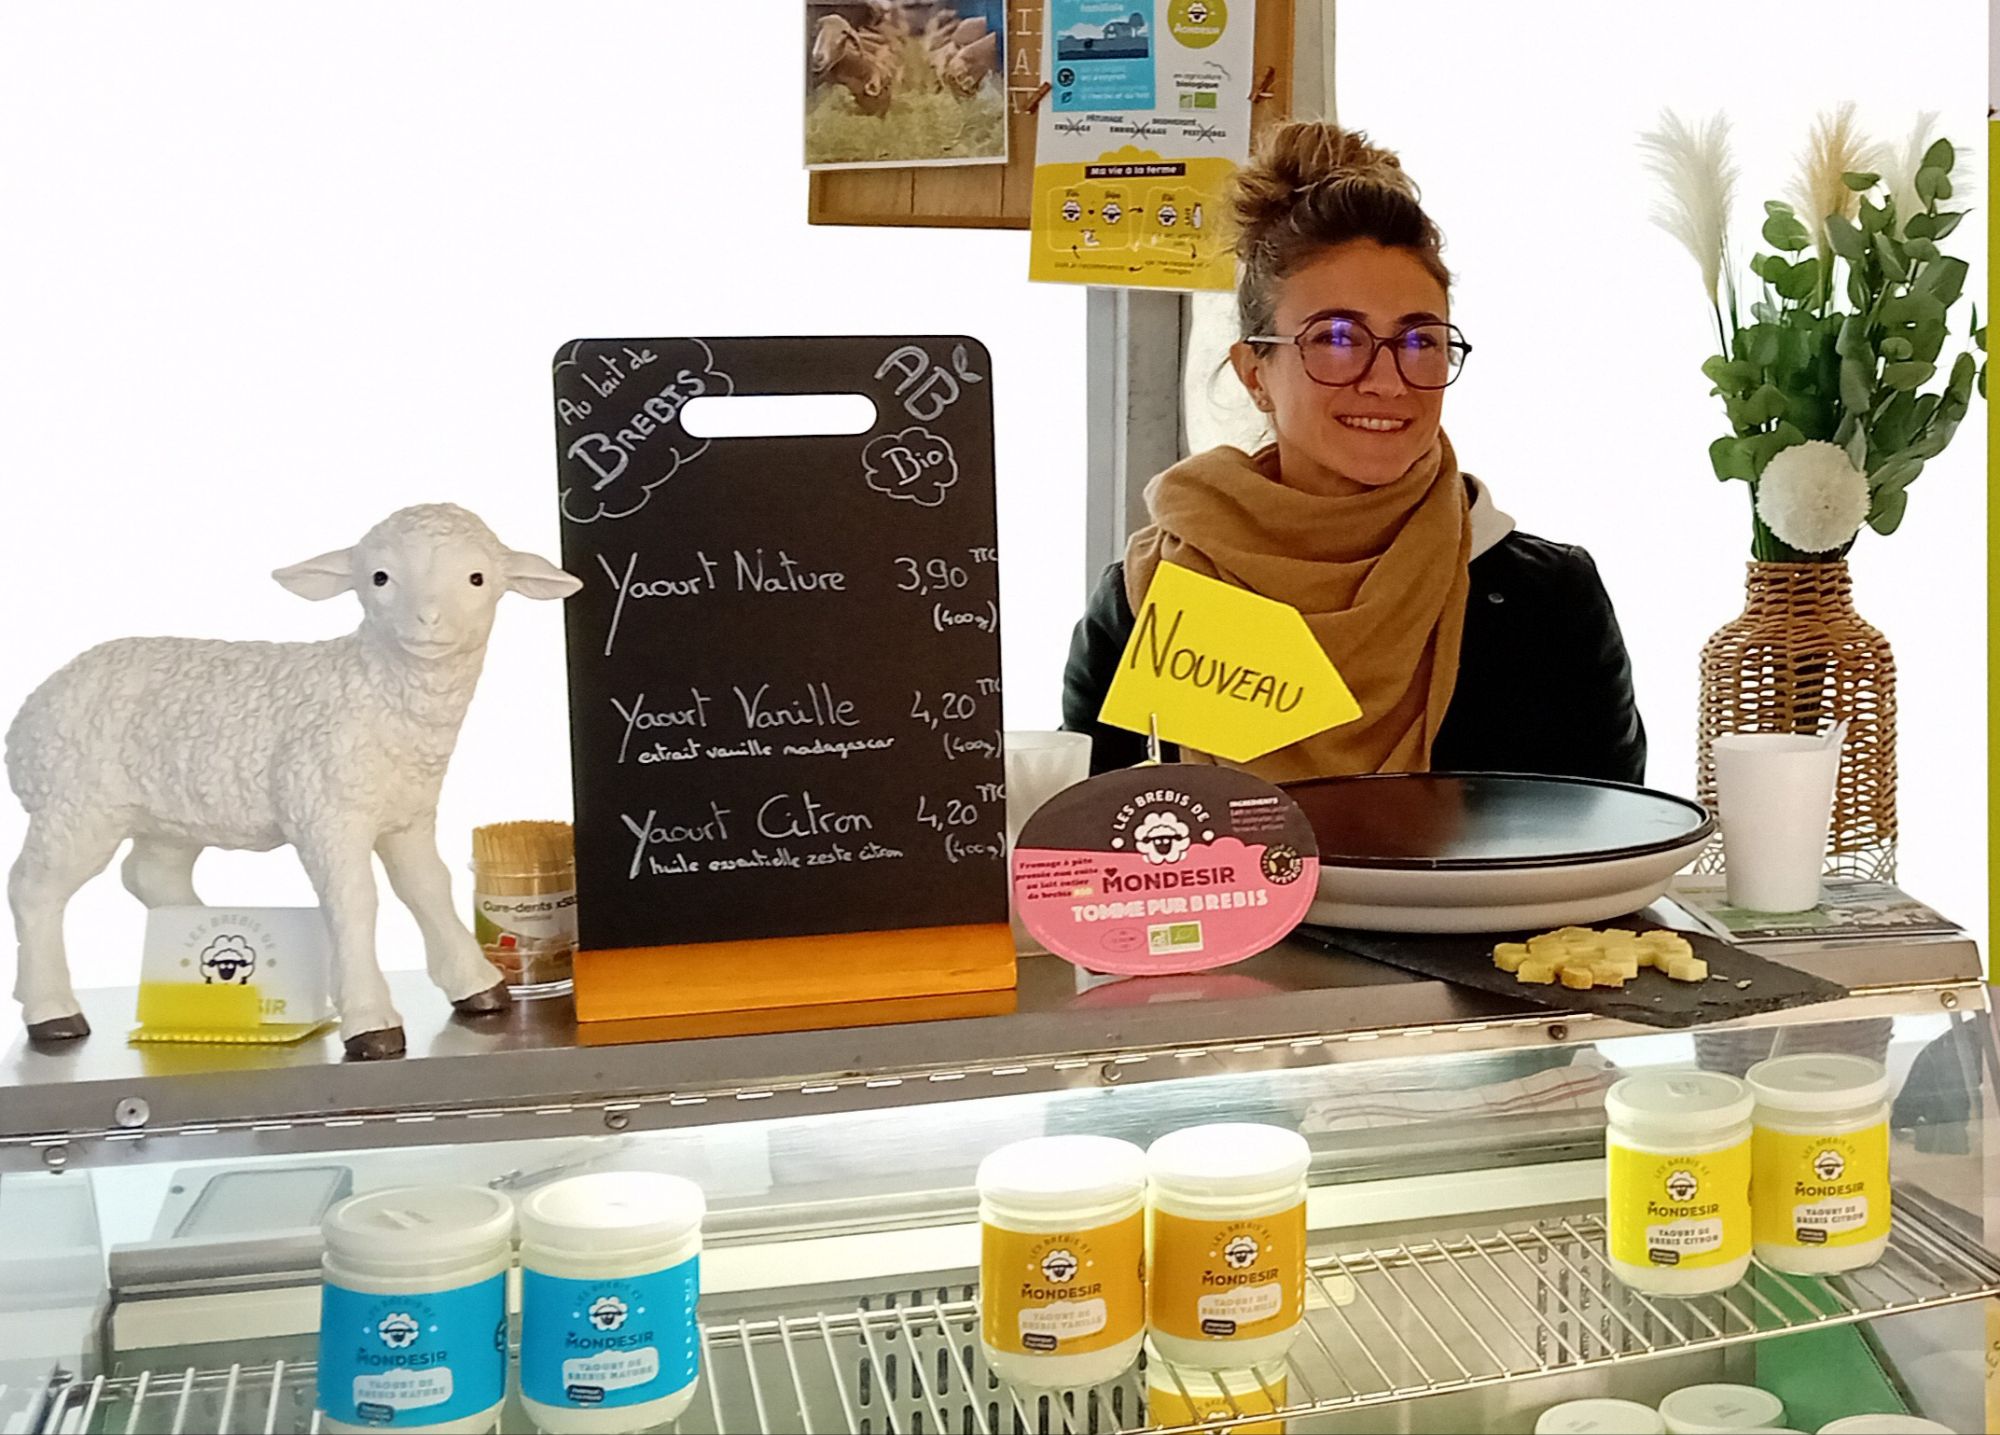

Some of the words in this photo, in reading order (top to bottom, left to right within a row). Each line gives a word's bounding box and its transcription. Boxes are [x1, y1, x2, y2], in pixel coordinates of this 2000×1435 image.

[1089, 166, 1107, 176] Ma
[1107, 166, 1123, 176] vie
[1134, 165, 1144, 175] la
[1146, 165, 1177, 175] ferme
[558, 397, 592, 426] Au
[581, 354, 626, 398] lait
[622, 347, 658, 370] de
[873, 345, 959, 421] AB
[567, 369, 706, 492] BREBIS
[881, 447, 943, 486] Bio
[597, 551, 718, 656] Yaourt
[734, 548, 846, 593] Nature
[894, 557, 968, 596] 3,90
[933, 600, 998, 633] (400g)
[1130, 602, 1304, 713] NOUVEAU
[610, 687, 713, 763] Yaourt
[733, 682, 860, 729] Vanille
[911, 690, 976, 730] 4,20
[637, 738, 702, 764] extrait
[706, 740, 772, 759] vanille
[783, 736, 895, 761] madagascar
[1113, 806, 1135, 830] LES
[1134, 790, 1191, 808] BREBIS
[1190, 803, 1210, 823] DE
[620, 801, 731, 880] Yaourt
[756, 791, 873, 840] Citron
[917, 796, 978, 831] 4,20
[649, 853, 701, 875] huile
[708, 846, 801, 872] essentielle
[806, 844, 853, 866] zeste
[858, 842, 905, 860] citron
[1019, 860, 1061, 869] Fromage
[1040, 880, 1057, 888] lait
[1060, 879, 1089, 887] entier
[1102, 866, 1236, 894] MONDESIR
[482, 899, 553, 913] Cure-dents
[1071, 899, 1146, 922] TOMME
[1147, 896, 1188, 916] PUR
[1190, 889, 1269, 913] BREBIS
[1795, 1182, 1865, 1196] MONDESIR
[1647, 1204, 1719, 1217] MONDESIR
[1021, 1283, 1102, 1300] MONDESIR
[1202, 1268, 1279, 1286] MONDESIR
[565, 1331, 653, 1349] MONDESIR
[356, 1351, 447, 1367] MONDESIR
